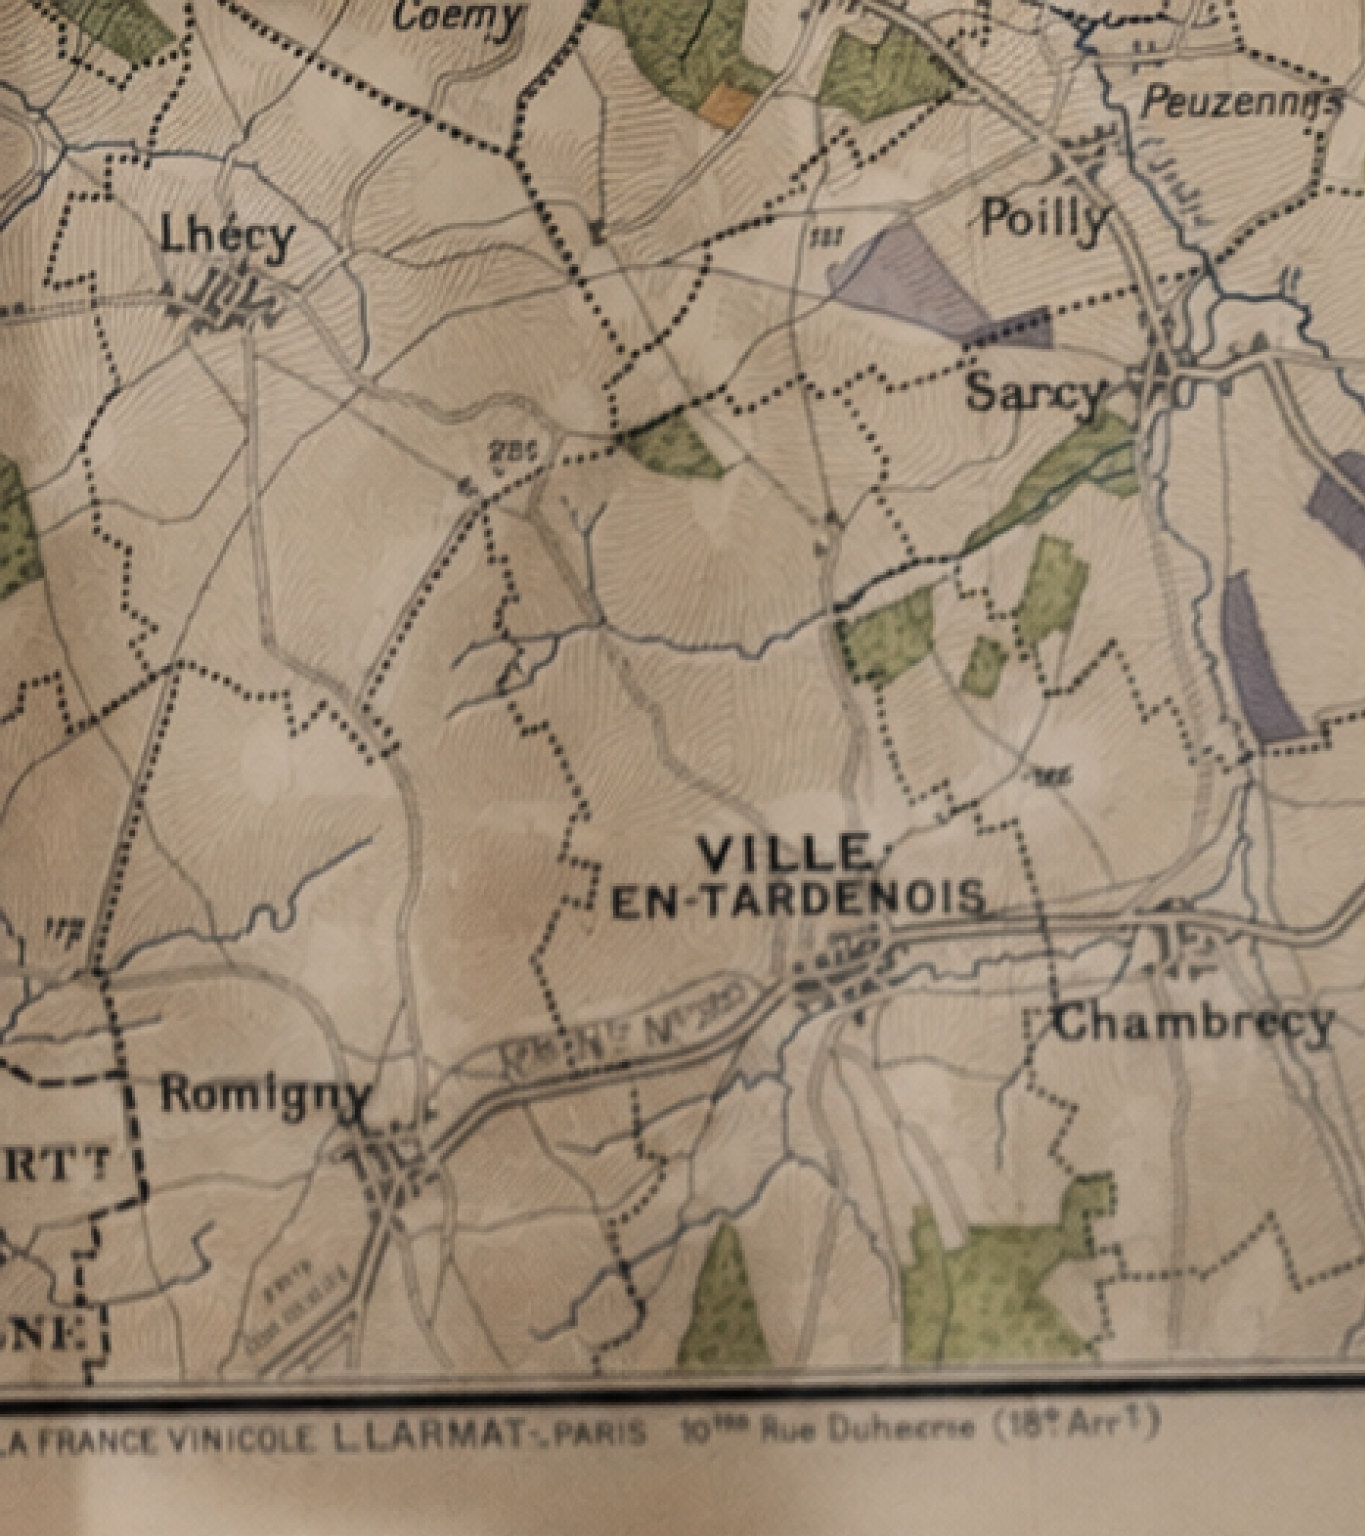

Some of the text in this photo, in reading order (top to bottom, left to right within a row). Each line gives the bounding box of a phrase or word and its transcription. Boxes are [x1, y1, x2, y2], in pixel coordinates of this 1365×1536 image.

[982, 194, 1118, 251] Poilly
[965, 369, 1109, 425] Sarcy
[697, 831, 878, 875] VILLE
[611, 877, 987, 919] EN-TARDENOIS
[1051, 998, 1336, 1052] Chambrecy
[160, 1070, 375, 1128] Romigny
[38, 1427, 157, 1457] FRANCE
[167, 1423, 314, 1454] VINICOLE
